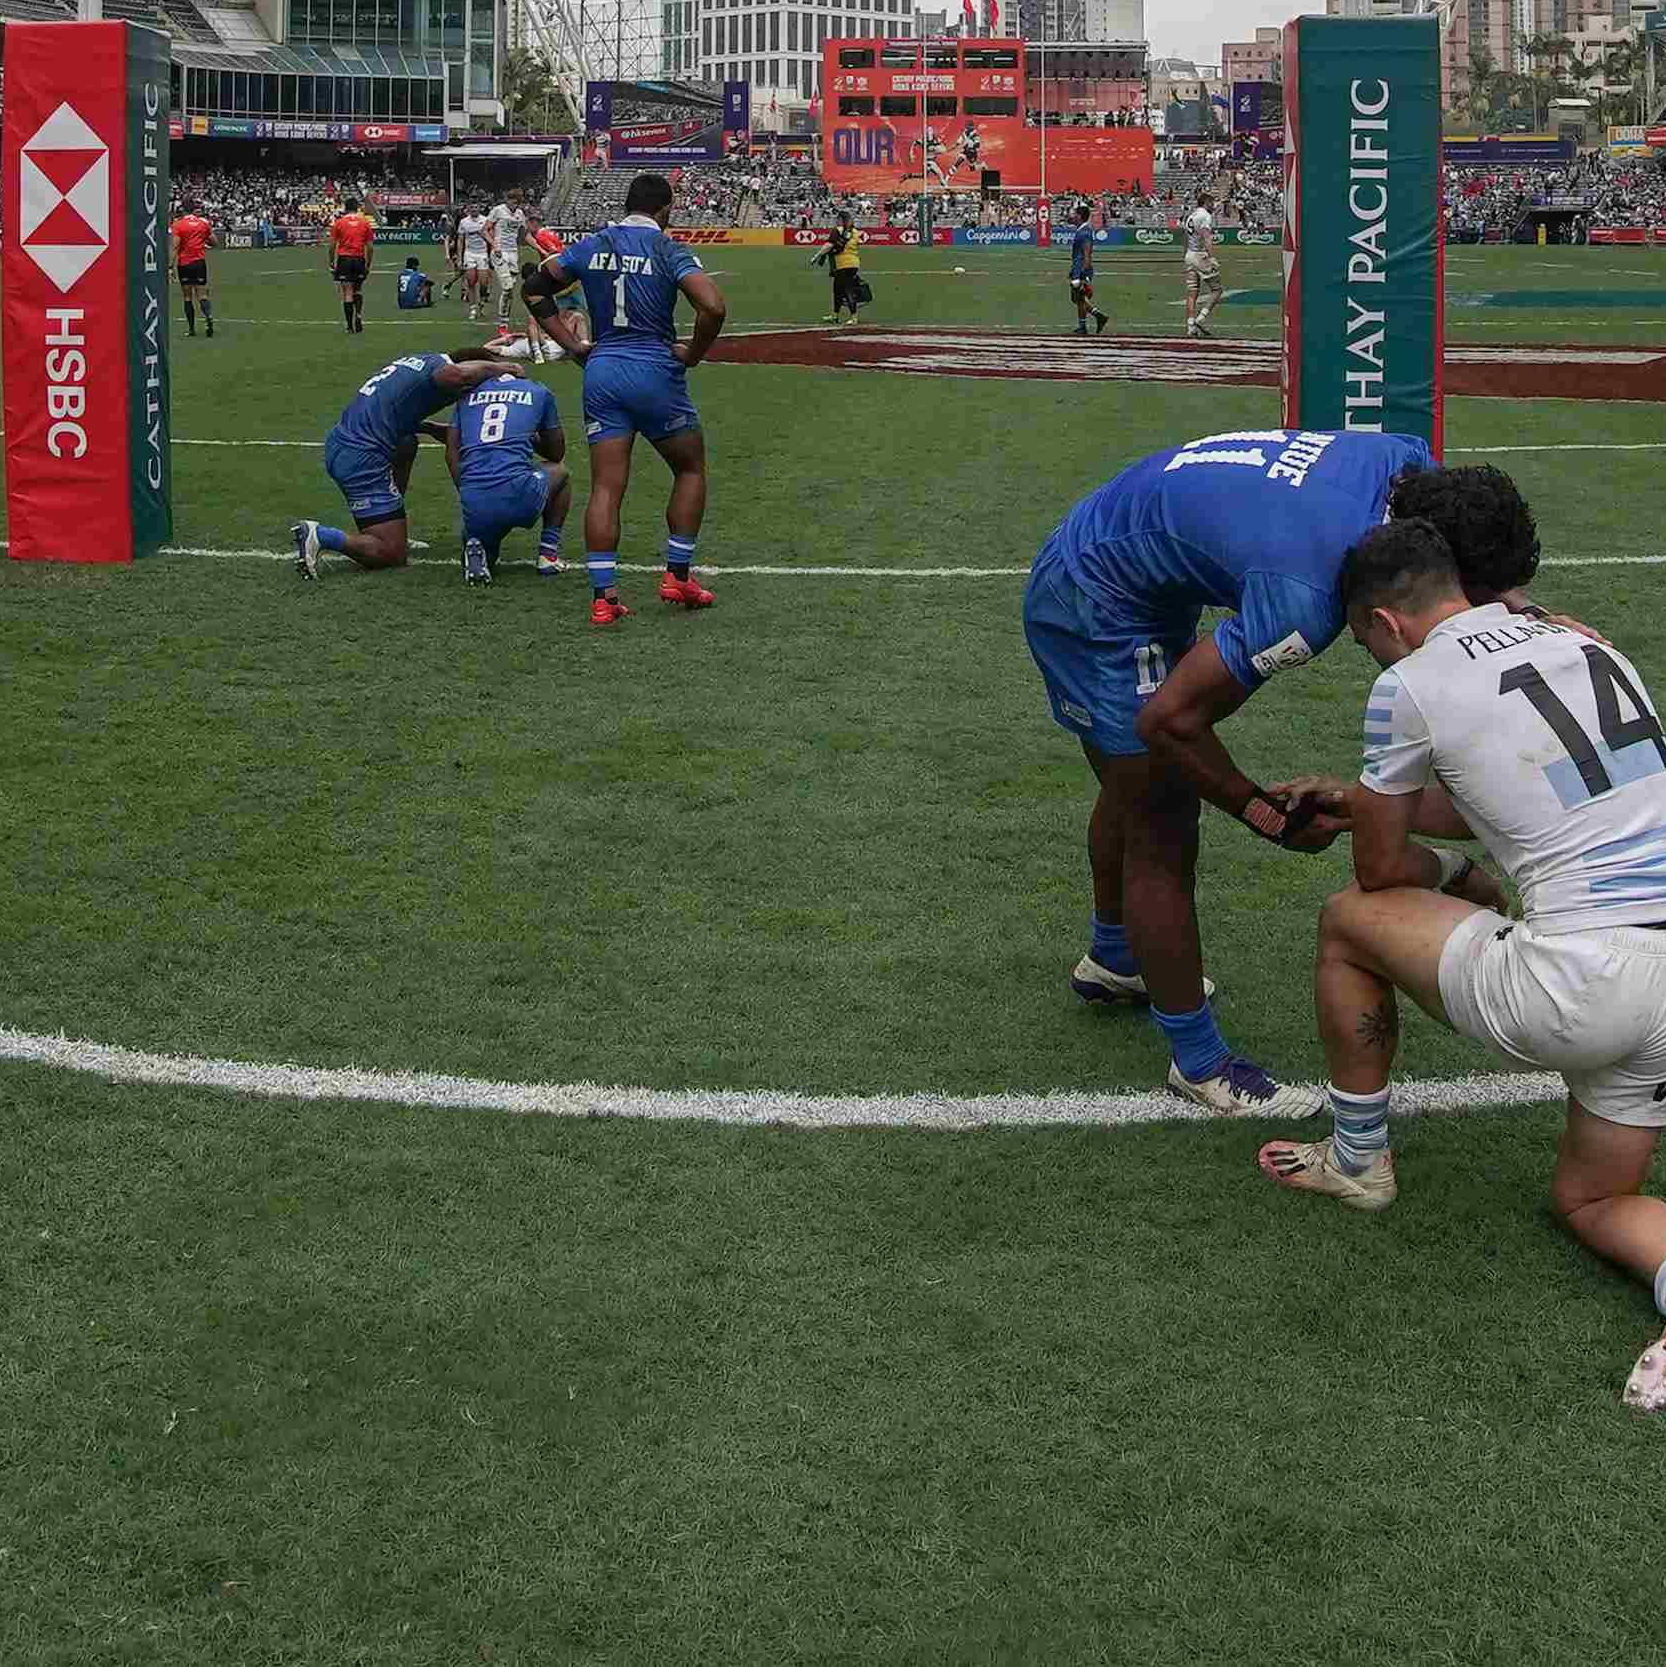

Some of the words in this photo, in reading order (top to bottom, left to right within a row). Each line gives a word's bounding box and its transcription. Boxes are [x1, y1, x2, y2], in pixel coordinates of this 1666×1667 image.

[143, 82, 160, 272] PACIFIC
[1346, 77, 1391, 283] PACIFIC
[386, 231, 421, 243] PACIFIC
[966, 228, 1019, 245] Capgemini
[1135, 229, 1174, 244] Carlsberg
[1237, 229, 1275, 244] Carlsberg
[399, 274, 410, 292] 3
[588, 252, 618, 271] AFA
[621, 255, 654, 276] SU'A
[613, 274, 629, 327] 1
[44, 307, 88, 459] HSBC
[1344, 296, 1388, 433] THAY
[143, 287, 165, 489] CATHAY
[468, 390, 534, 407] LEITUFIA
[480, 402, 509, 444] 8
[1164, 429, 1289, 472] 11
